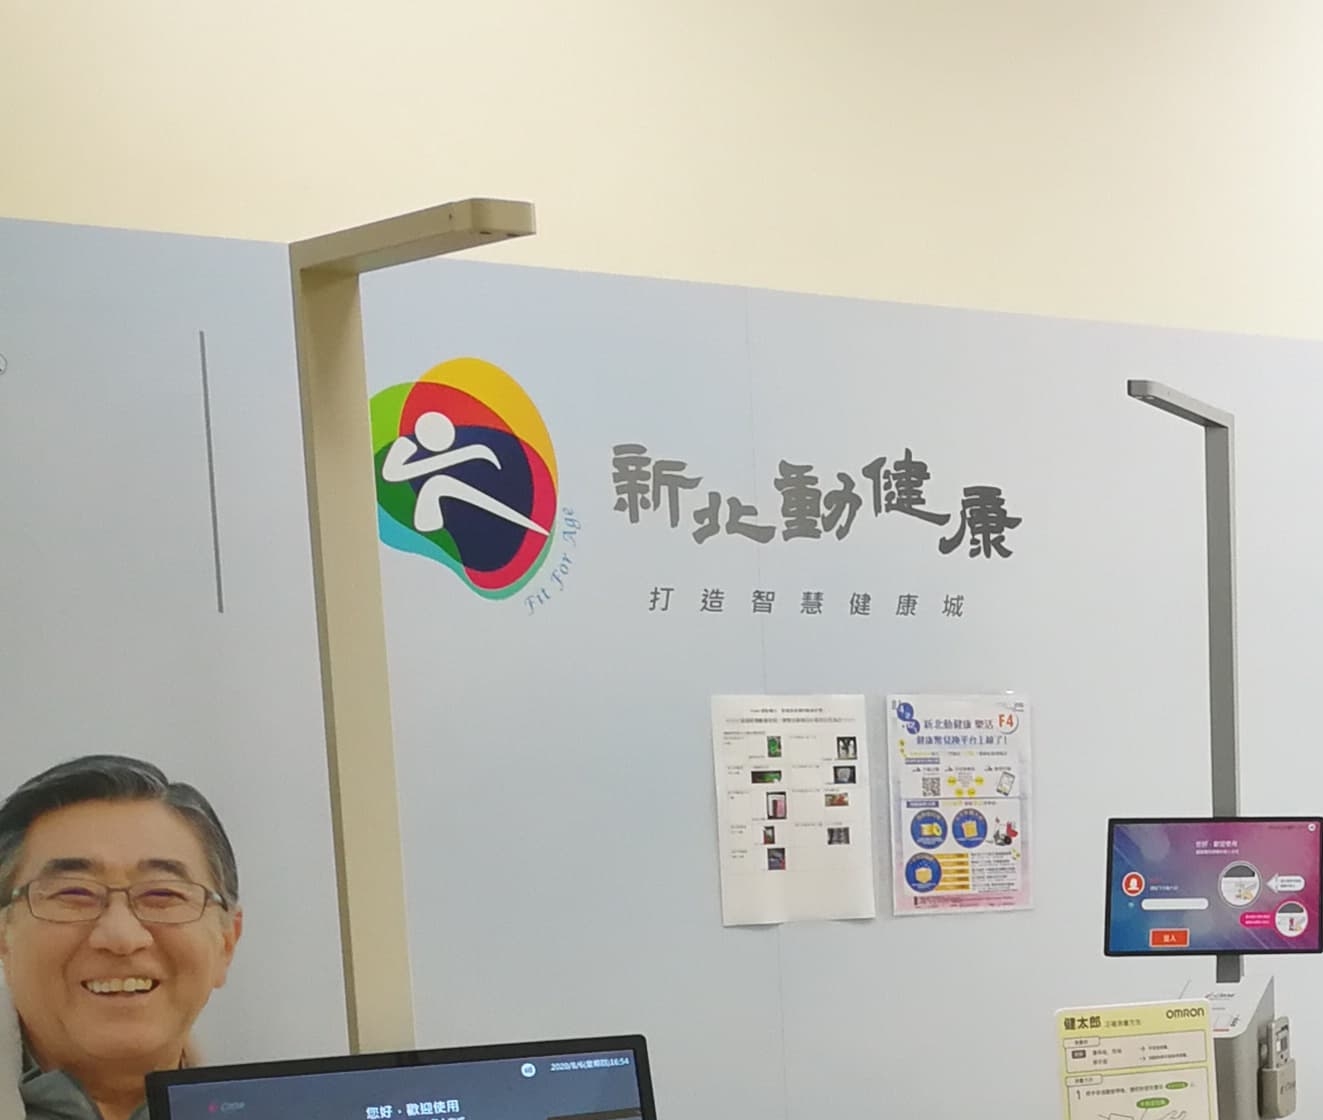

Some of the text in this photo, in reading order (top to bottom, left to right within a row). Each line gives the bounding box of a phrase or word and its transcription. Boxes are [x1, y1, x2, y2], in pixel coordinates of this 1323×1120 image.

[612, 443, 1023, 559] 新北動健康
[524, 507, 581, 616] Fit For Age
[648, 587, 966, 620] 打造智慧健康城
[1064, 1015, 1102, 1030] 健太郎
